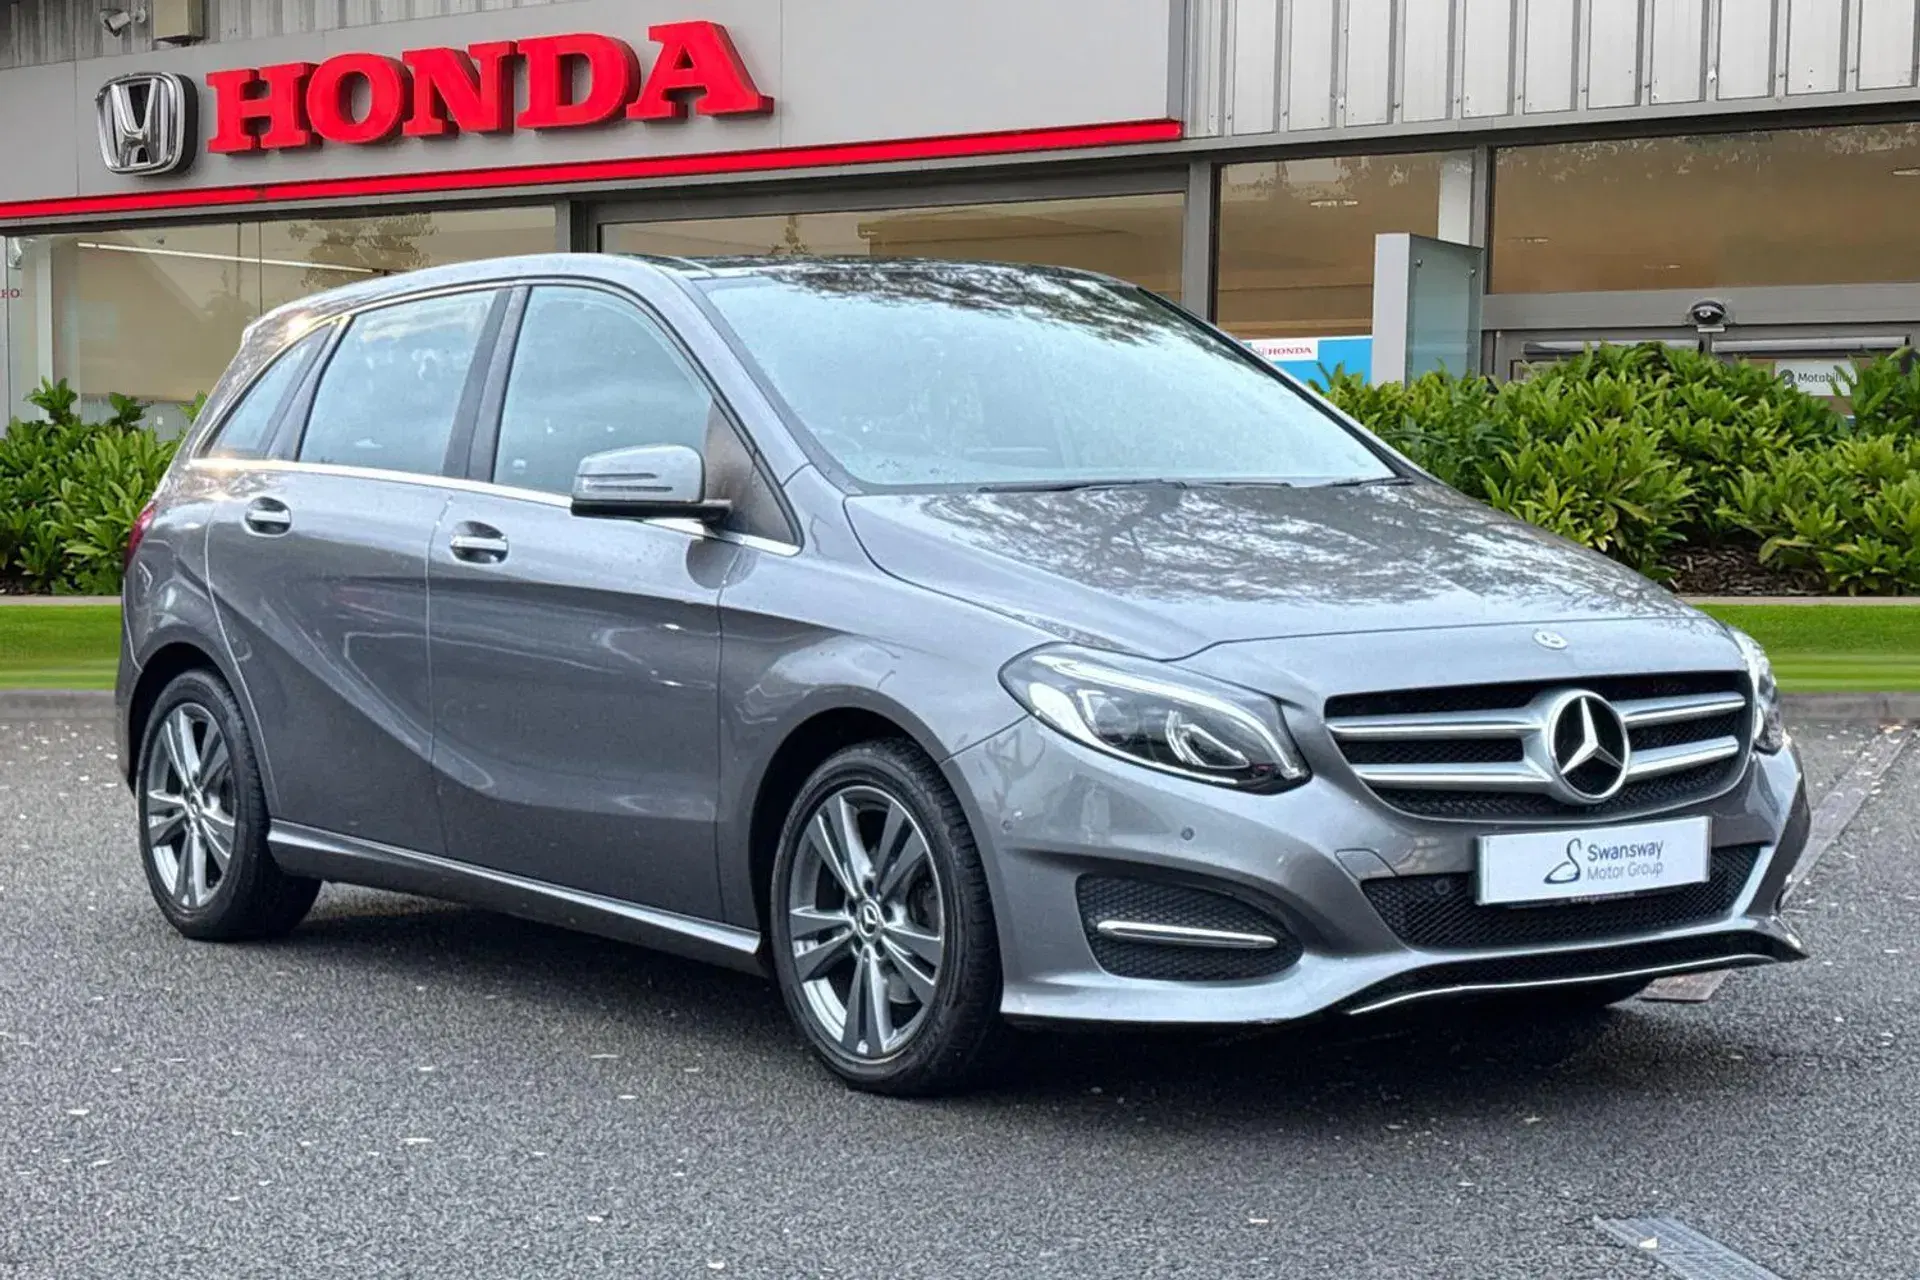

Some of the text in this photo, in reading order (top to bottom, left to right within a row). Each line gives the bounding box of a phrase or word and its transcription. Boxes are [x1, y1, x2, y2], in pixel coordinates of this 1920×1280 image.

[206, 20, 774, 154] HONDA
[1268, 346, 1312, 356] HONDA
[1587, 840, 1664, 862] Swansway
[1587, 861, 1664, 881] Motor Group
